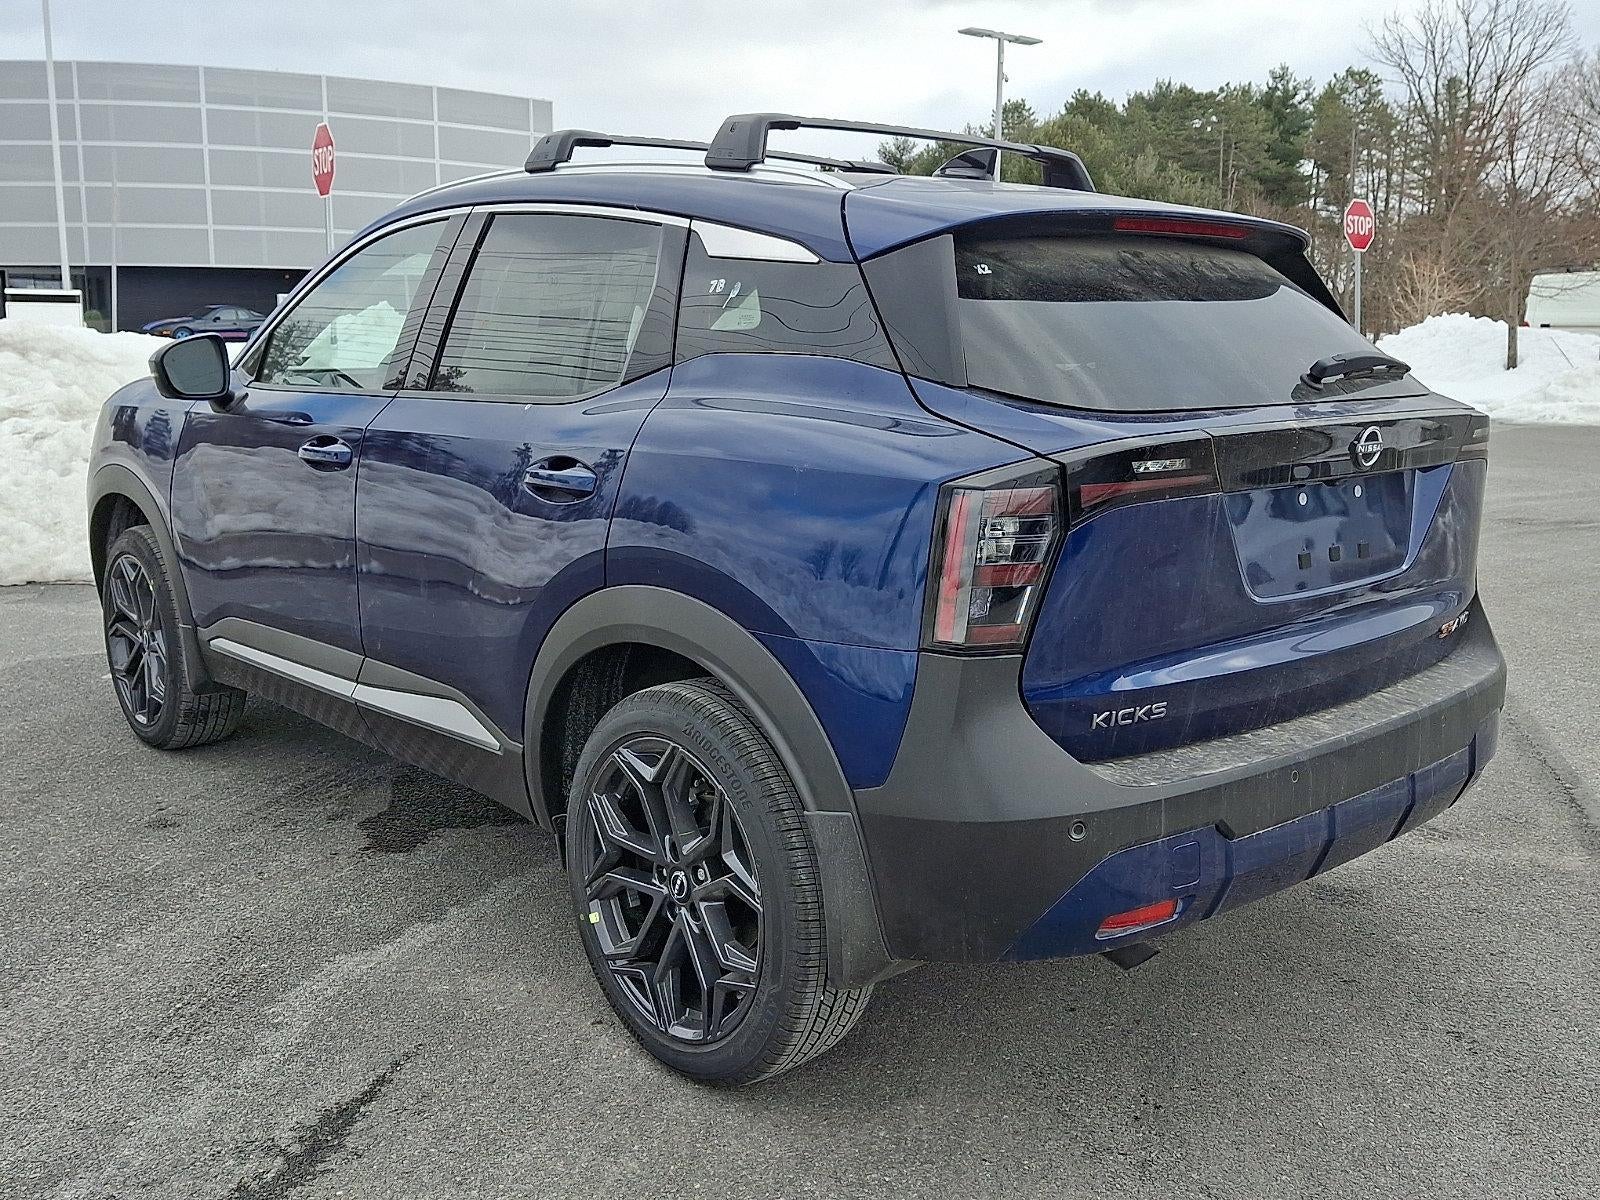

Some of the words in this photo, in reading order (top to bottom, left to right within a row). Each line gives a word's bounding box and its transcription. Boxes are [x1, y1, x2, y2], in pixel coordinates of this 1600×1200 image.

[314, 145, 333, 176] STOP
[1347, 215, 1372, 236] STOP
[1358, 444, 1384, 453] NISSA
[1091, 701, 1168, 730] KICKS
[682, 722, 754, 810] BRIDGESTONE
